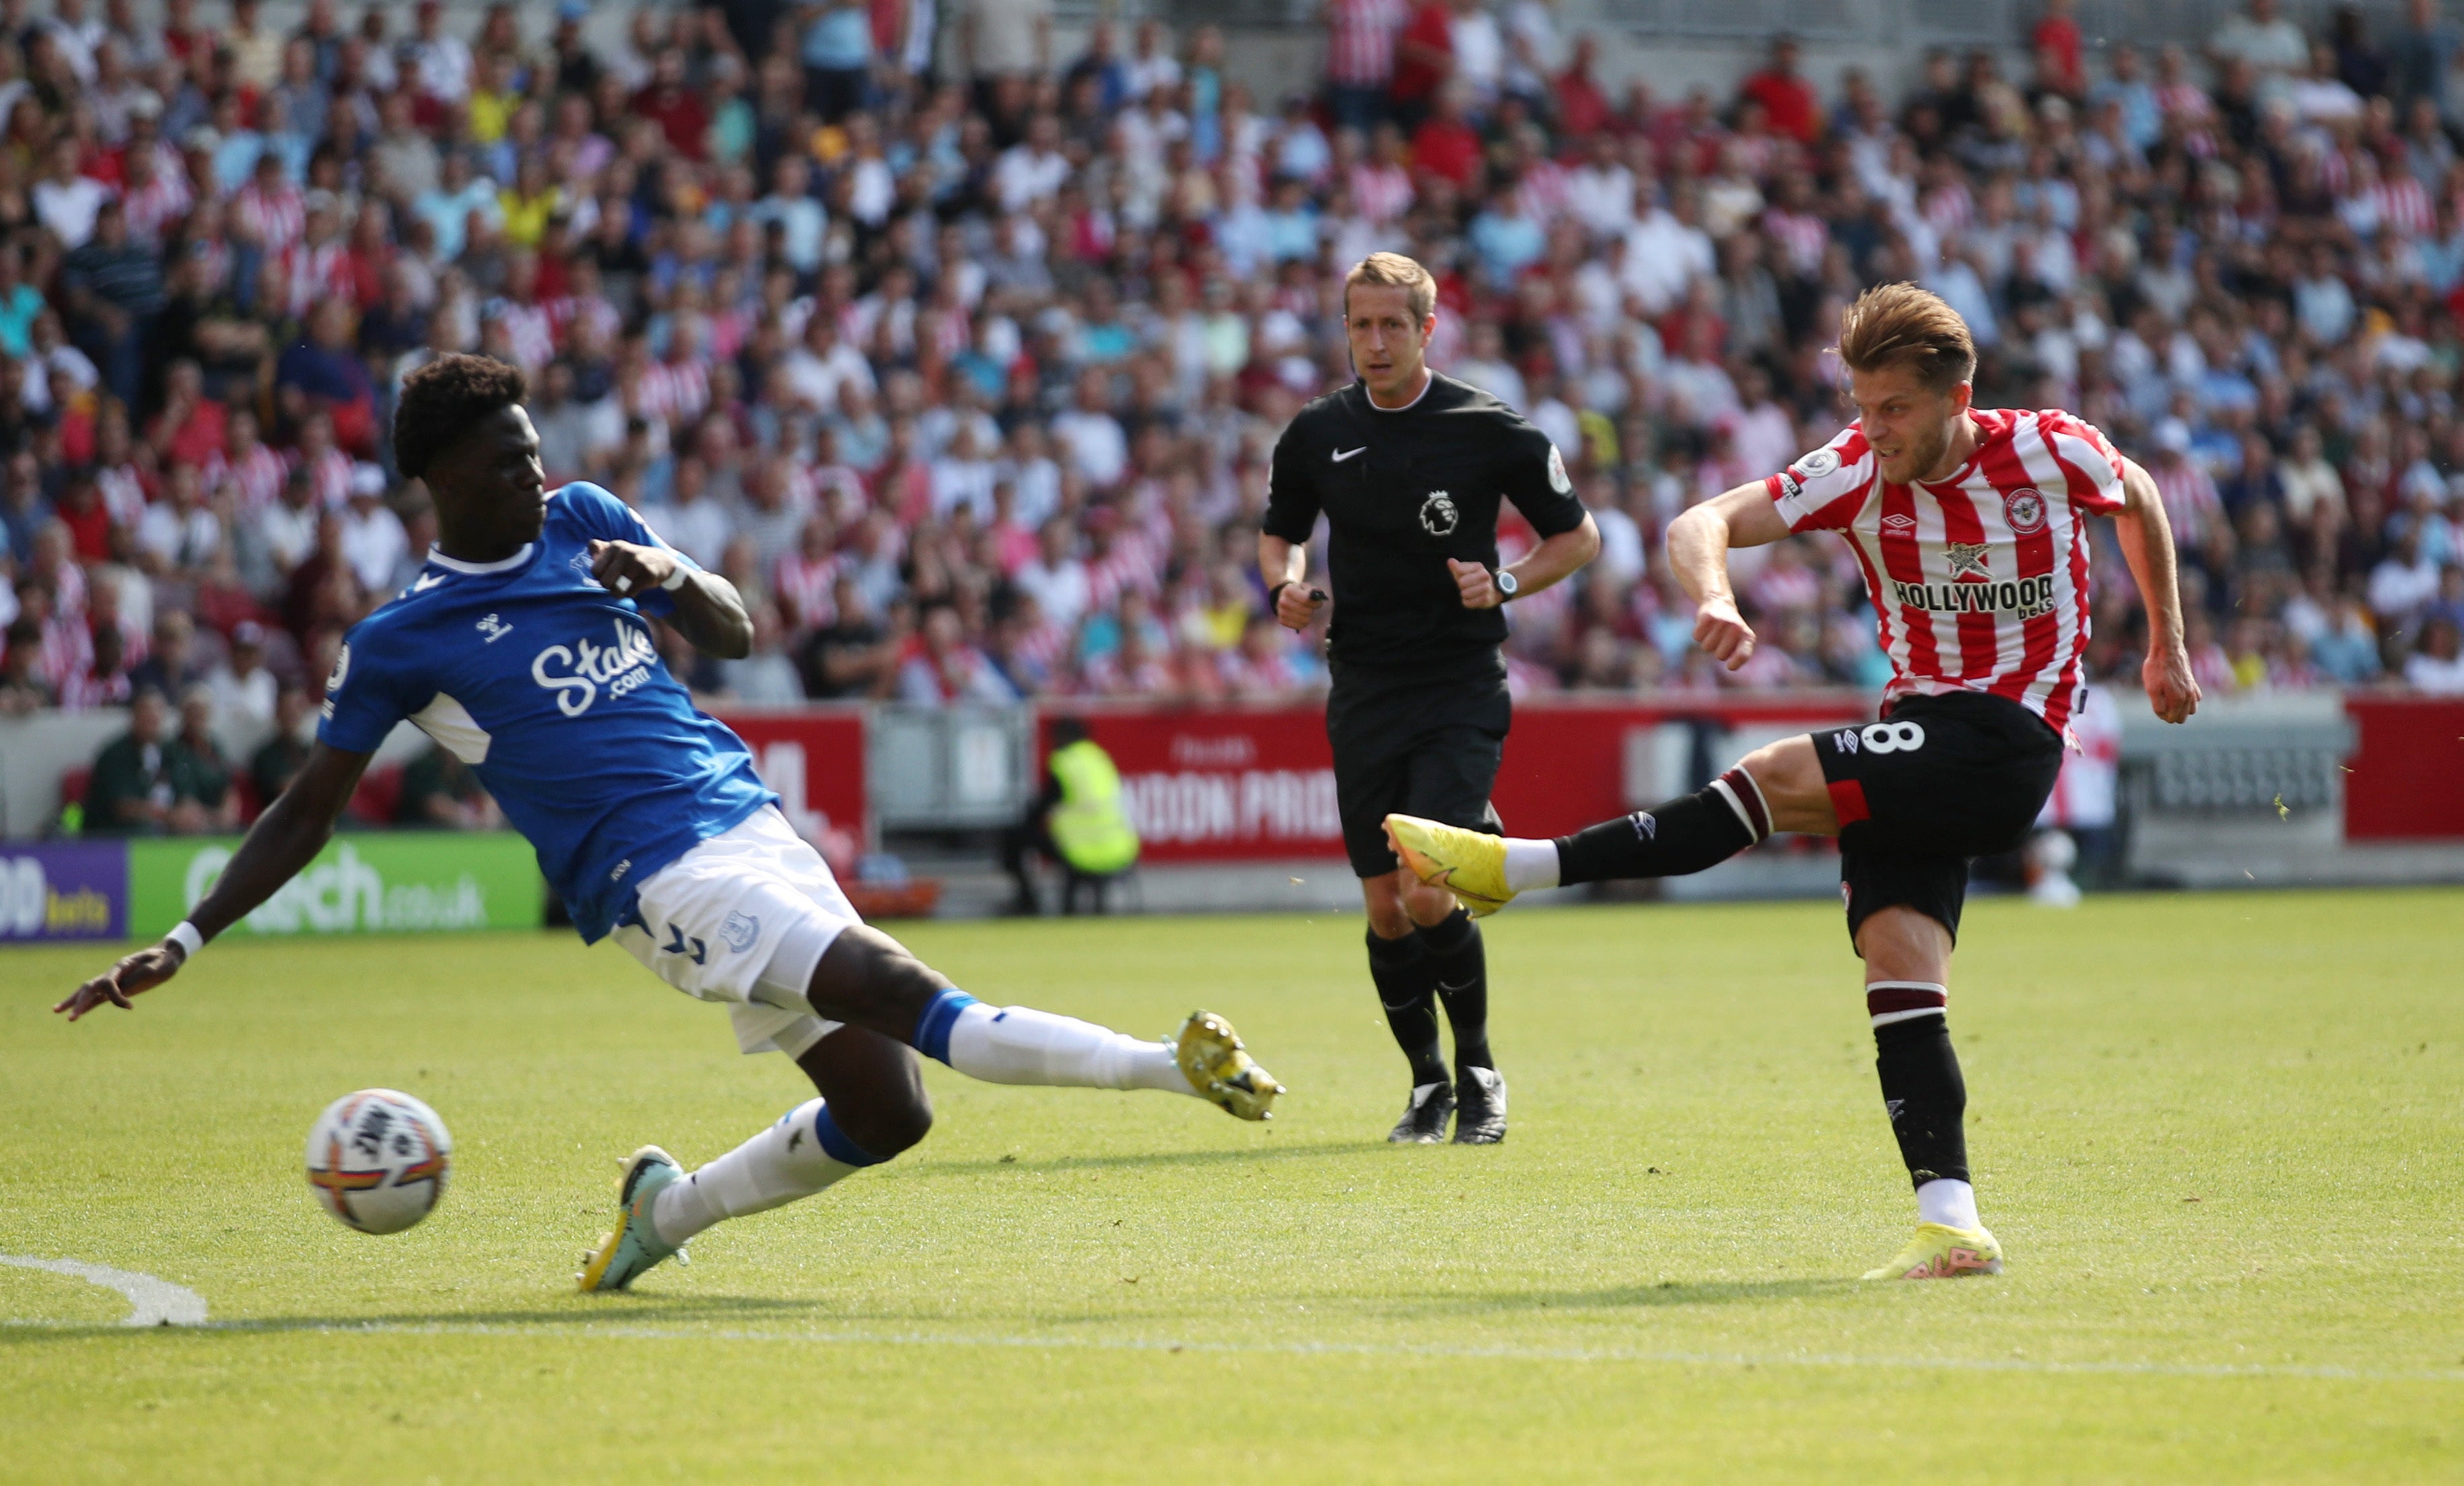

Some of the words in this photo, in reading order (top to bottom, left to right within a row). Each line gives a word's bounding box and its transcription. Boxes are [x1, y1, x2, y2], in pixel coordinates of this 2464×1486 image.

[1891, 574, 2053, 611] HOLLYWOOD
[2017, 599, 2055, 620] bets
[531, 617, 658, 718] Stake
[1861, 720, 1925, 754] 8
